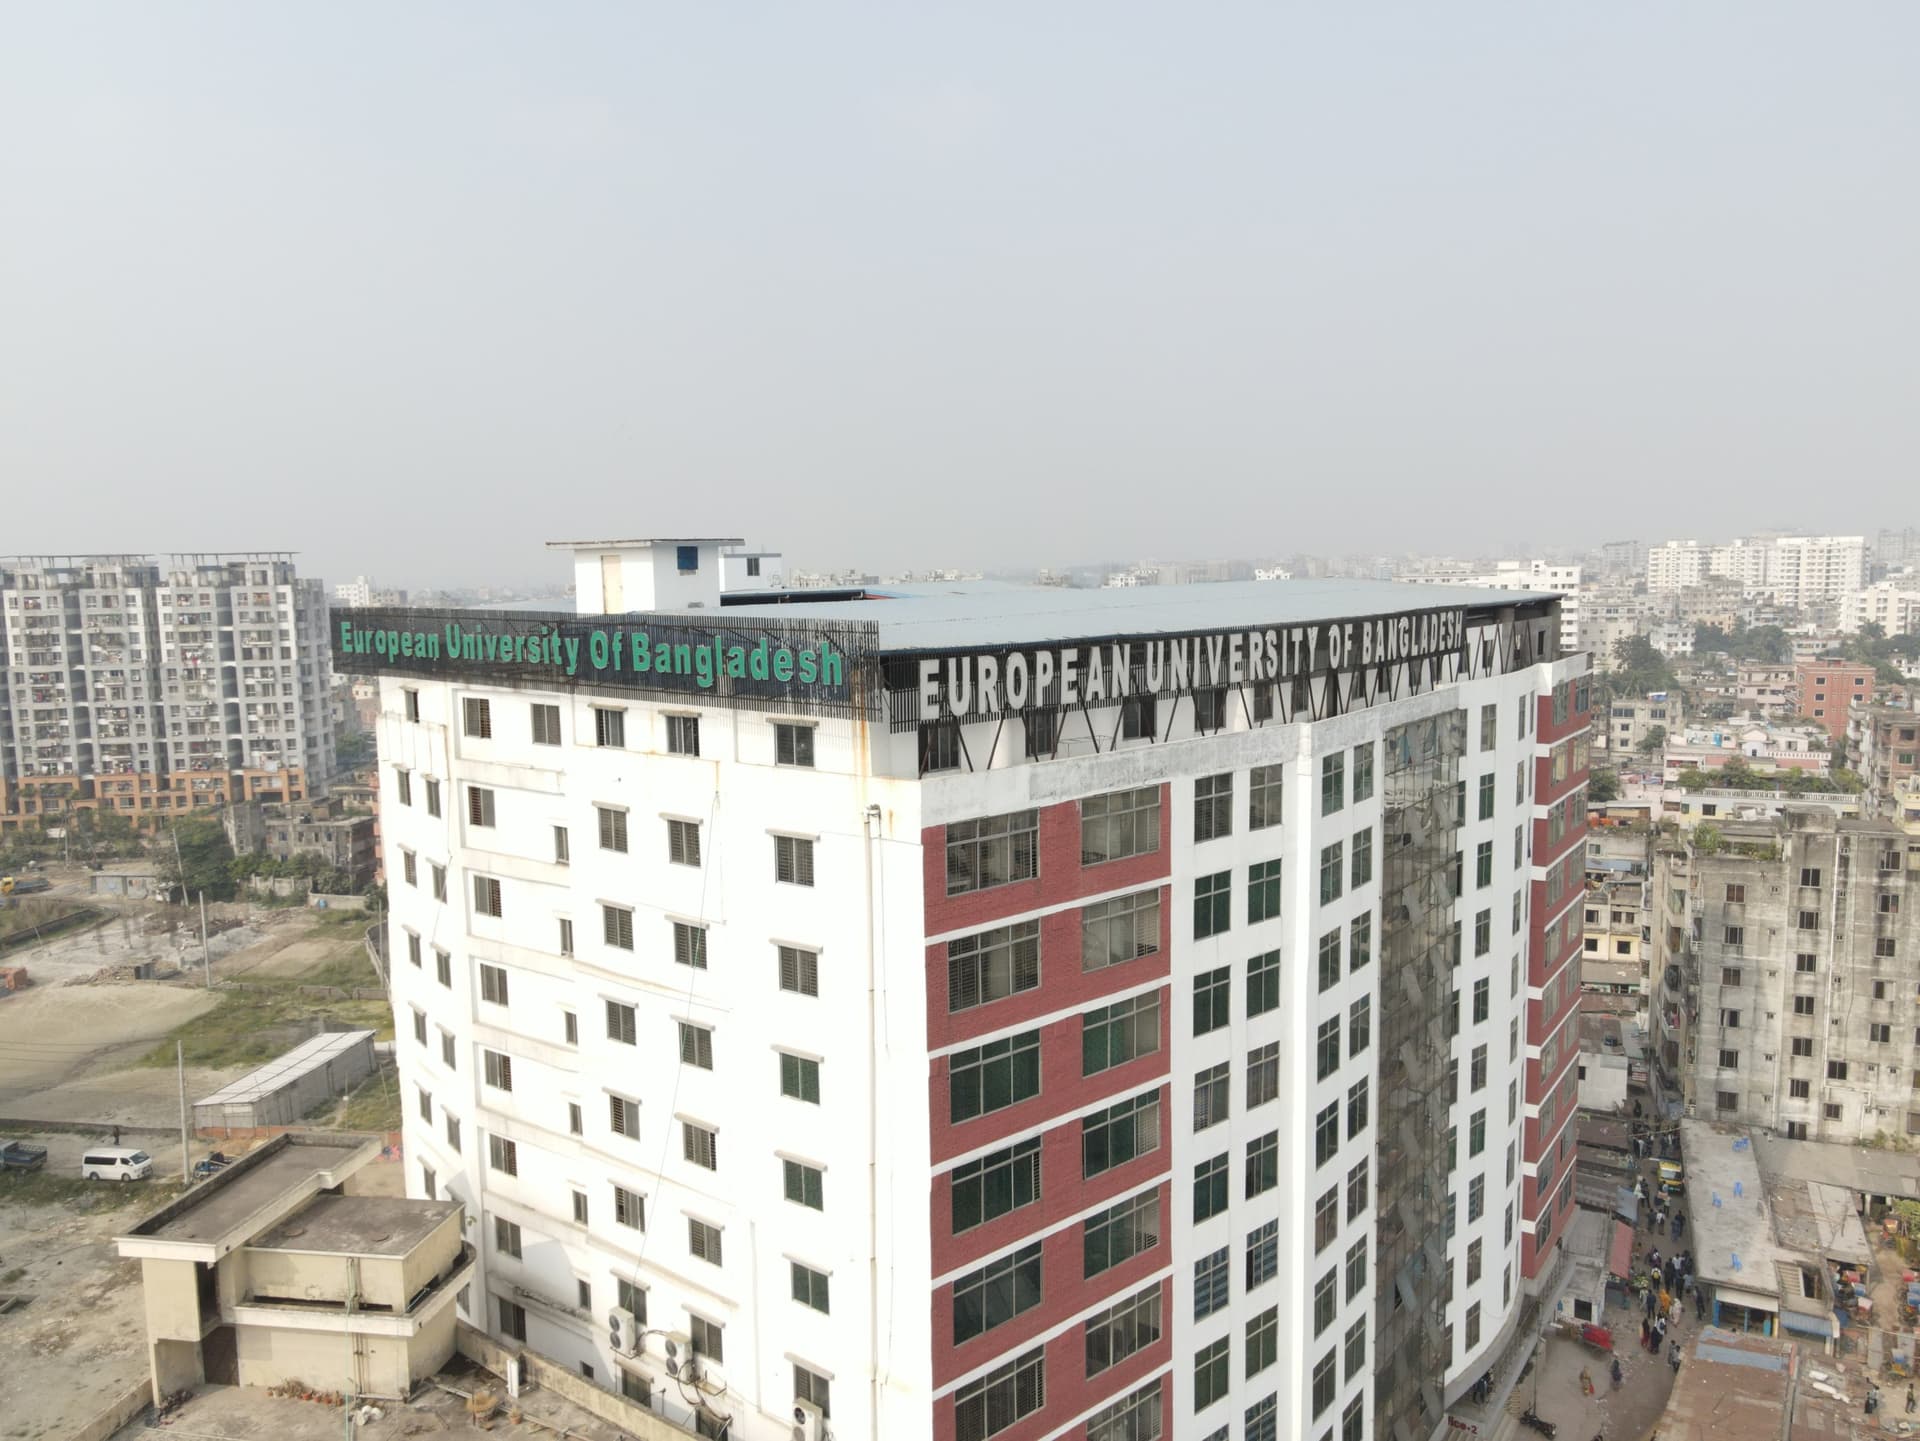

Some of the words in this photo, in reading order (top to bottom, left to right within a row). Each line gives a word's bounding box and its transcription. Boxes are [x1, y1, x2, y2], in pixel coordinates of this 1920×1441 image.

[340, 621, 440, 663] European
[445, 623, 579, 675] University
[590, 630, 623, 671] Of
[631, 632, 842, 688] Bangladesh
[919, 643, 1131, 720] EUROPEAN
[1145, 626, 1319, 693] UNIVERSITY
[1328, 623, 1352, 669] OF
[1362, 610, 1463, 665] BANGLADESH
